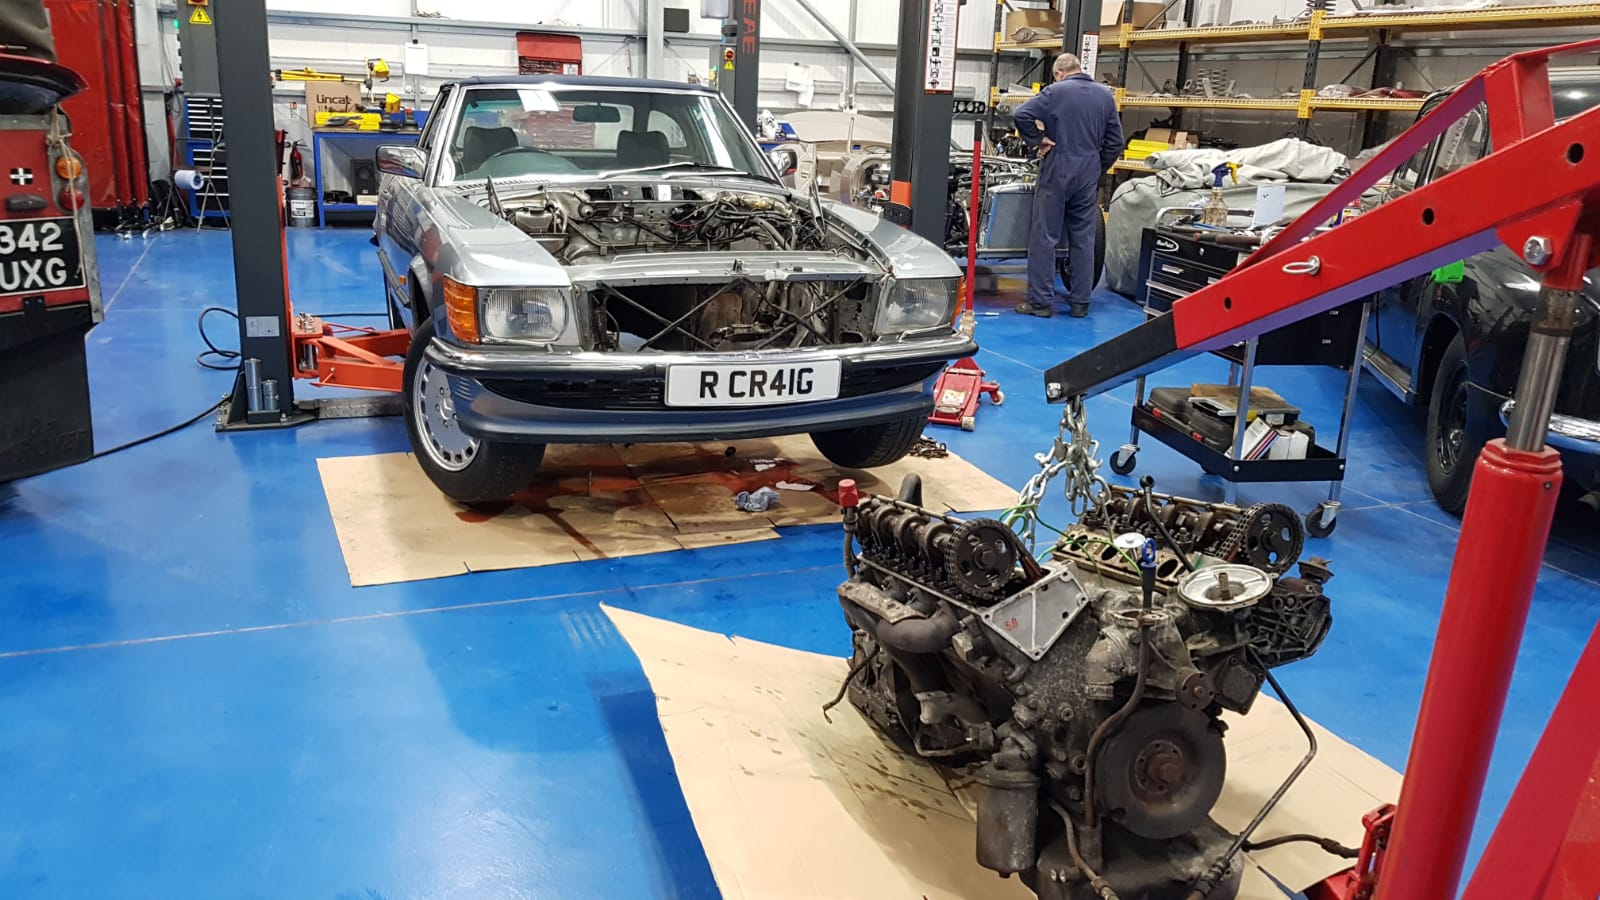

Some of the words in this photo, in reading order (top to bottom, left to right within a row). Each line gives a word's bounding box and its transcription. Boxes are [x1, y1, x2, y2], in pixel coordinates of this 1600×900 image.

[0, 222, 64, 255] 342
[0, 257, 67, 291] UXG
[700, 371, 718, 398] R
